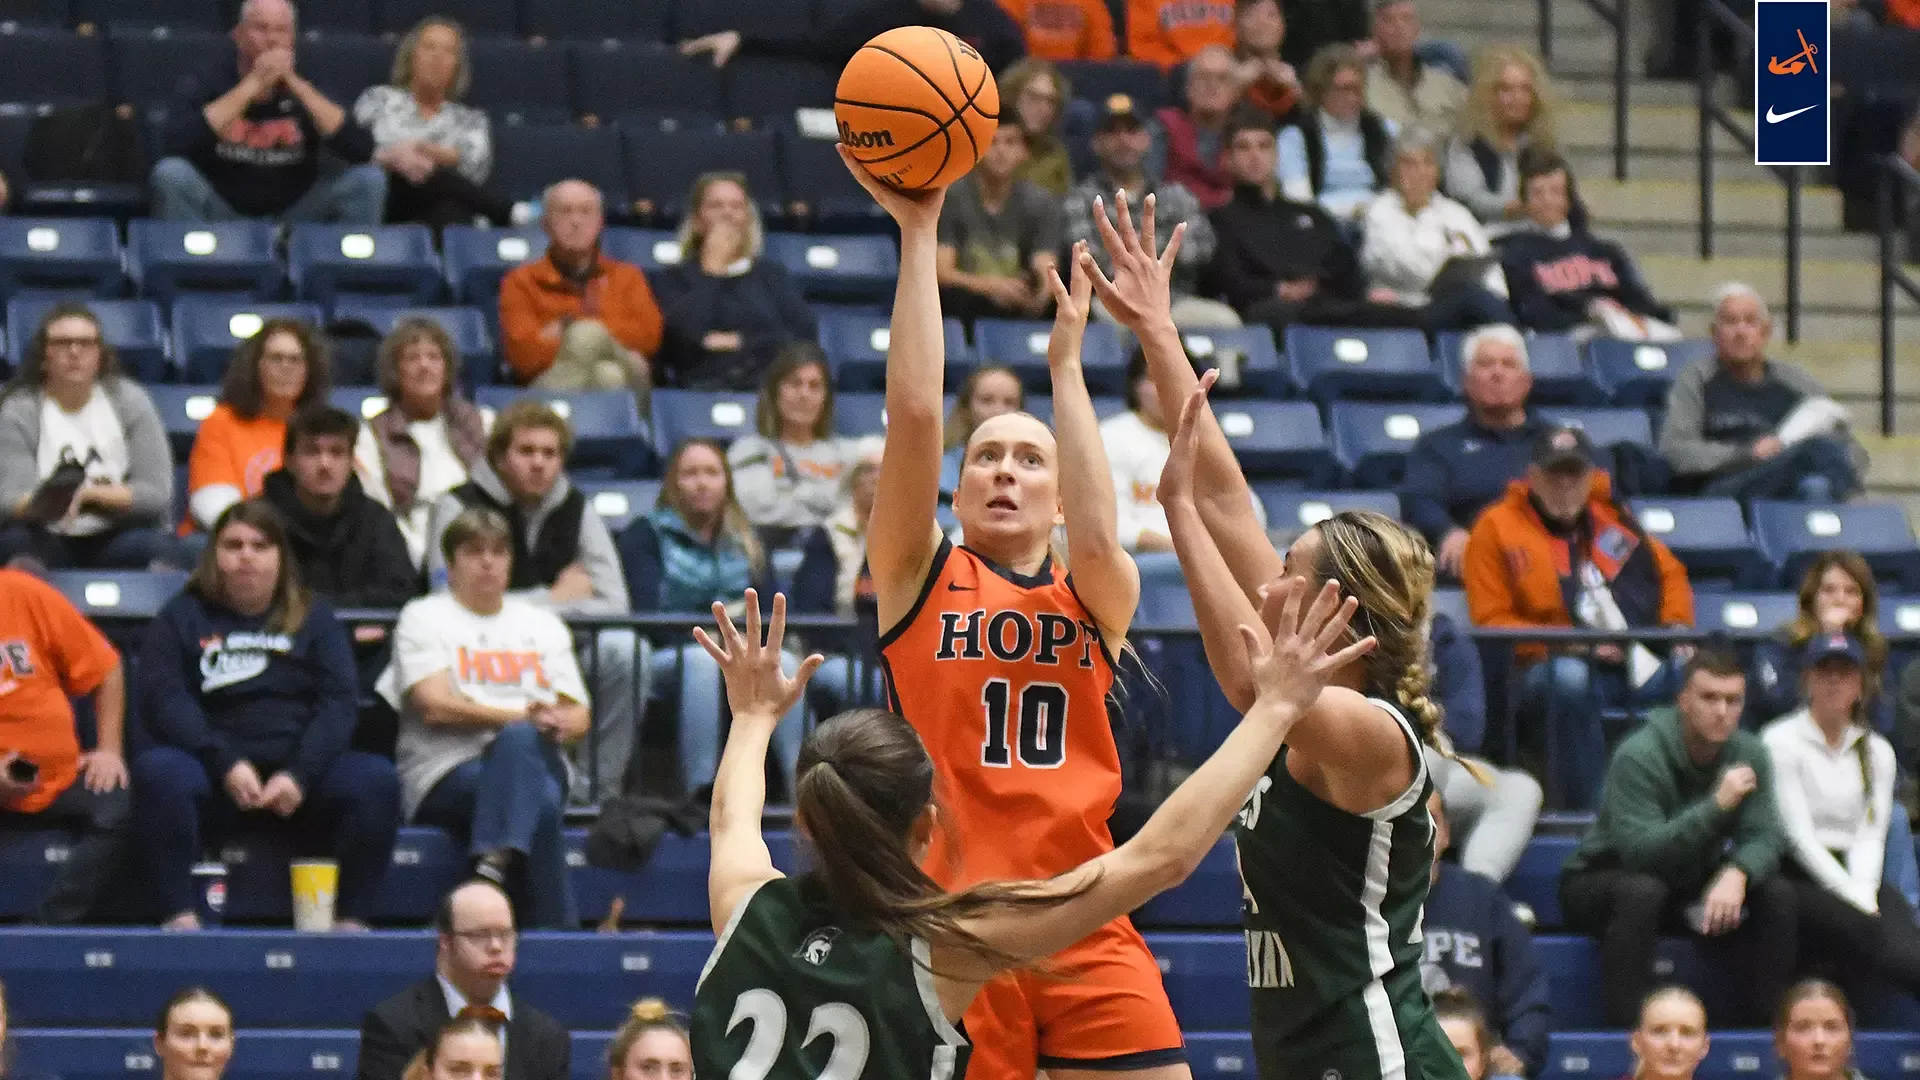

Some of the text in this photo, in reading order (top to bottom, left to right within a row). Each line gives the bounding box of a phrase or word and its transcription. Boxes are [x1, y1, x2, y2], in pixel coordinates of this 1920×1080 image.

[981, 677, 1069, 770] 10
[1419, 930, 1484, 968] PE
[725, 988, 870, 1080] 22
